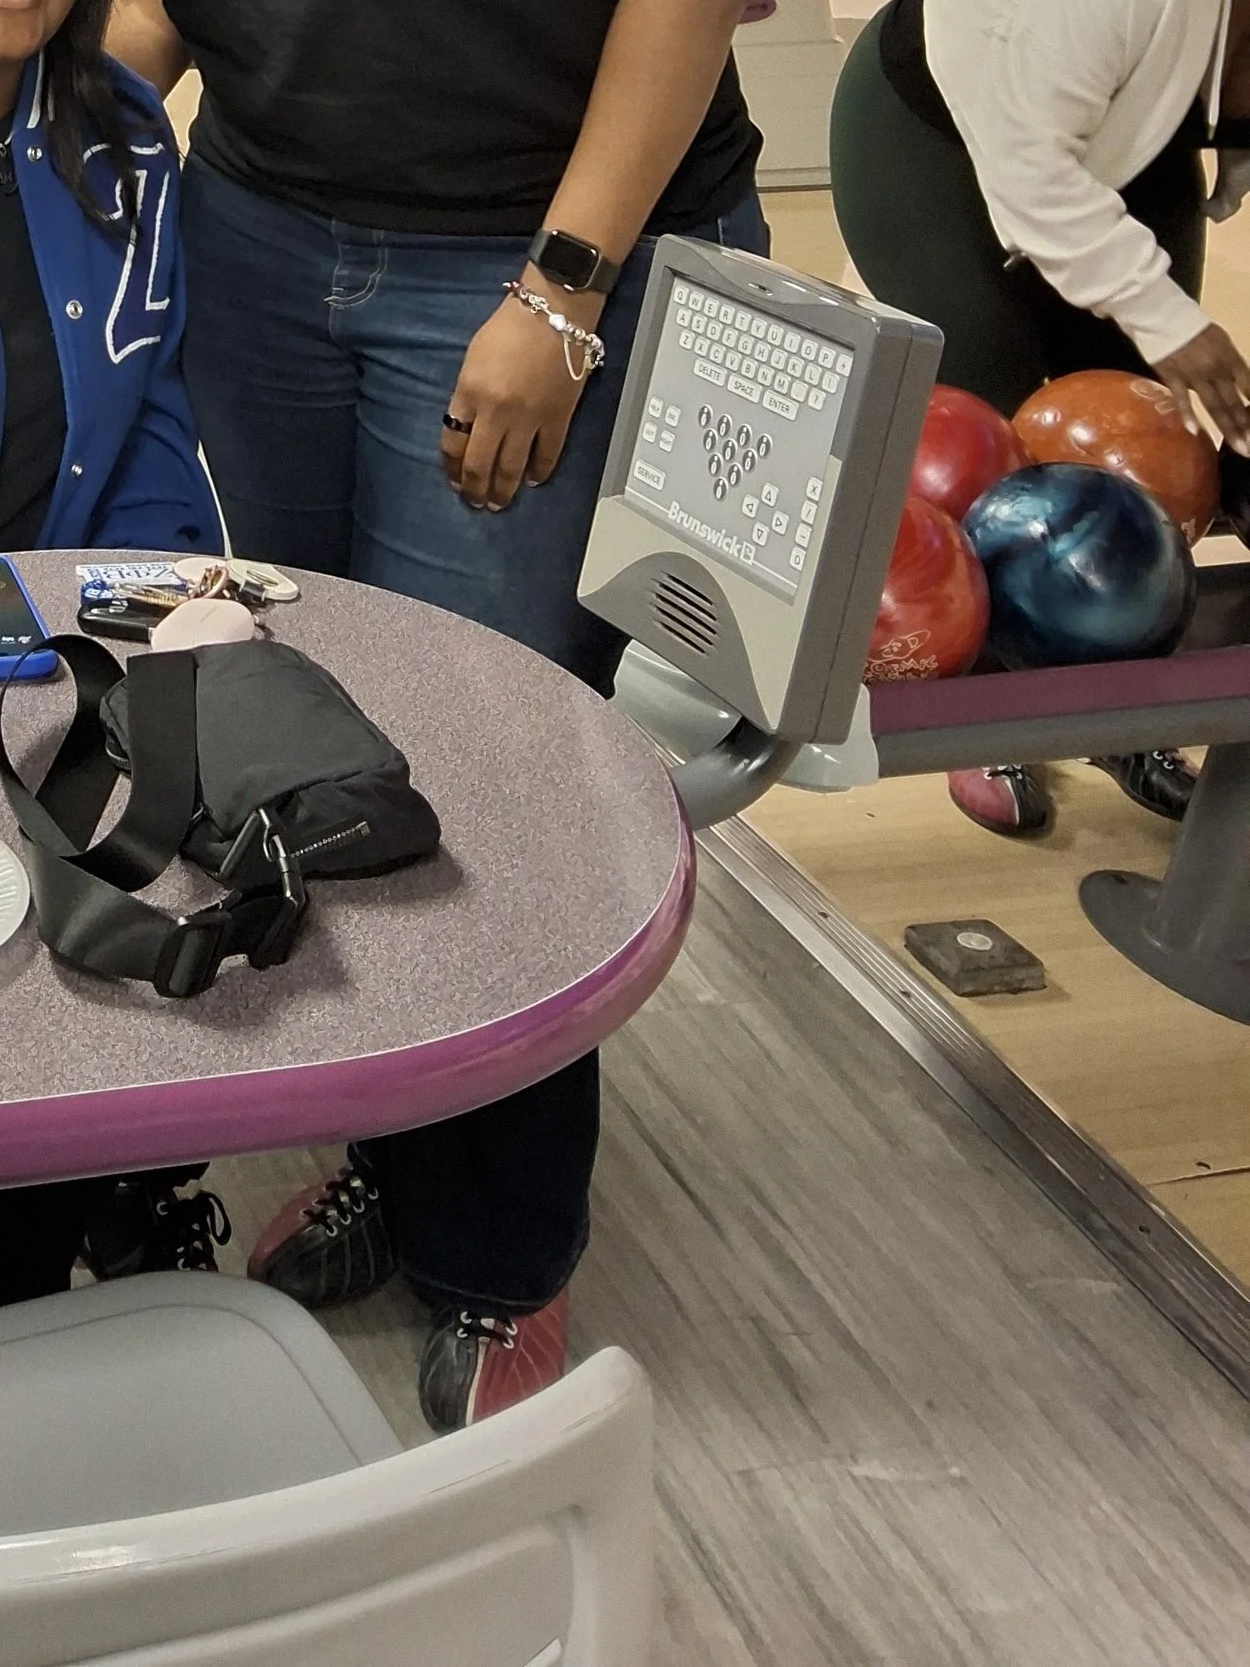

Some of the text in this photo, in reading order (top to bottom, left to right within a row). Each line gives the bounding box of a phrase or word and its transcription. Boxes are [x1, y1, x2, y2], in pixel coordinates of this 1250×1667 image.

[698, 364, 791, 414] DELETE SPACE ENTER
[637, 465, 662, 486] SERVICE
[668, 500, 741, 558] Brunswick
